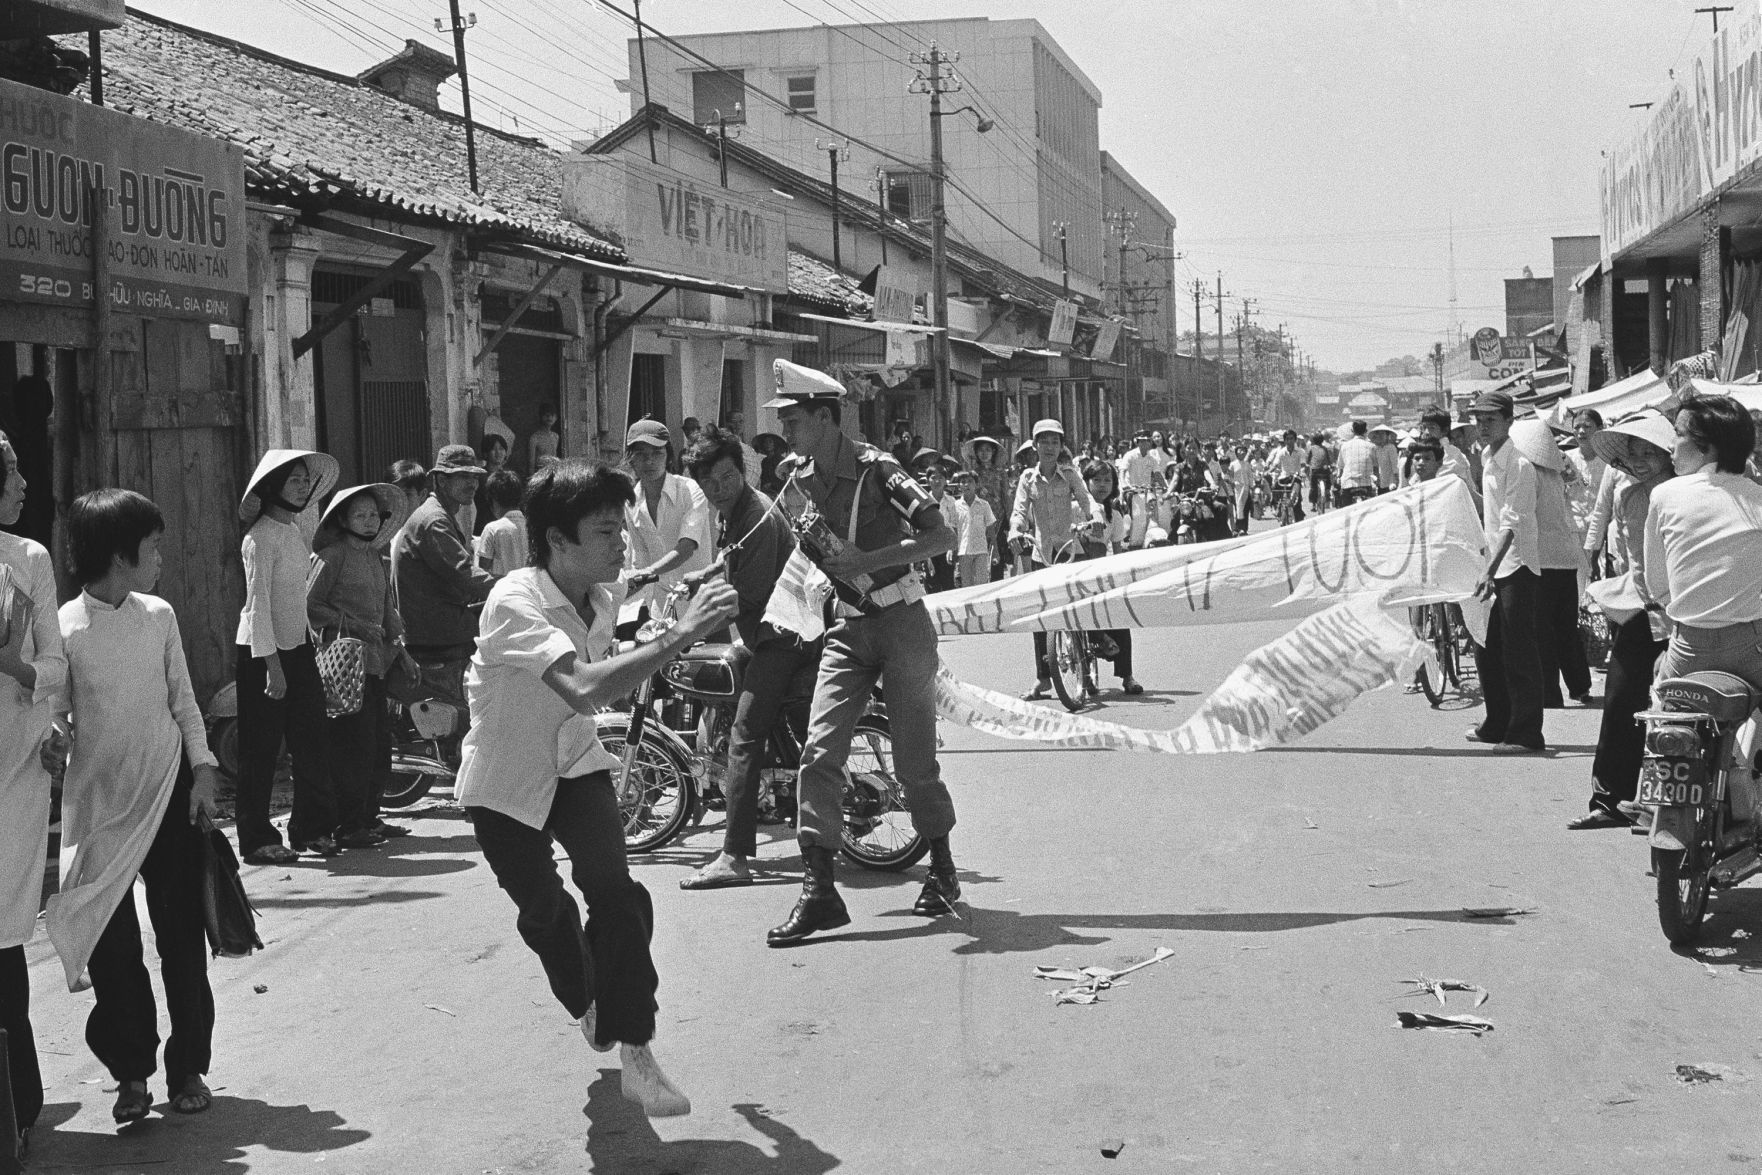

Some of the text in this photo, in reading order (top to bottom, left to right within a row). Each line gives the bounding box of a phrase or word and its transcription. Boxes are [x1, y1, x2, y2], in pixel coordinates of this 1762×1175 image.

[1713, 27, 1762, 174] Hyn
[20, 274, 71, 298] 320
[886, 471, 906, 491] 1721
[1665, 688, 1710, 704] HONDA
[1656, 760, 1690, 781] SC
